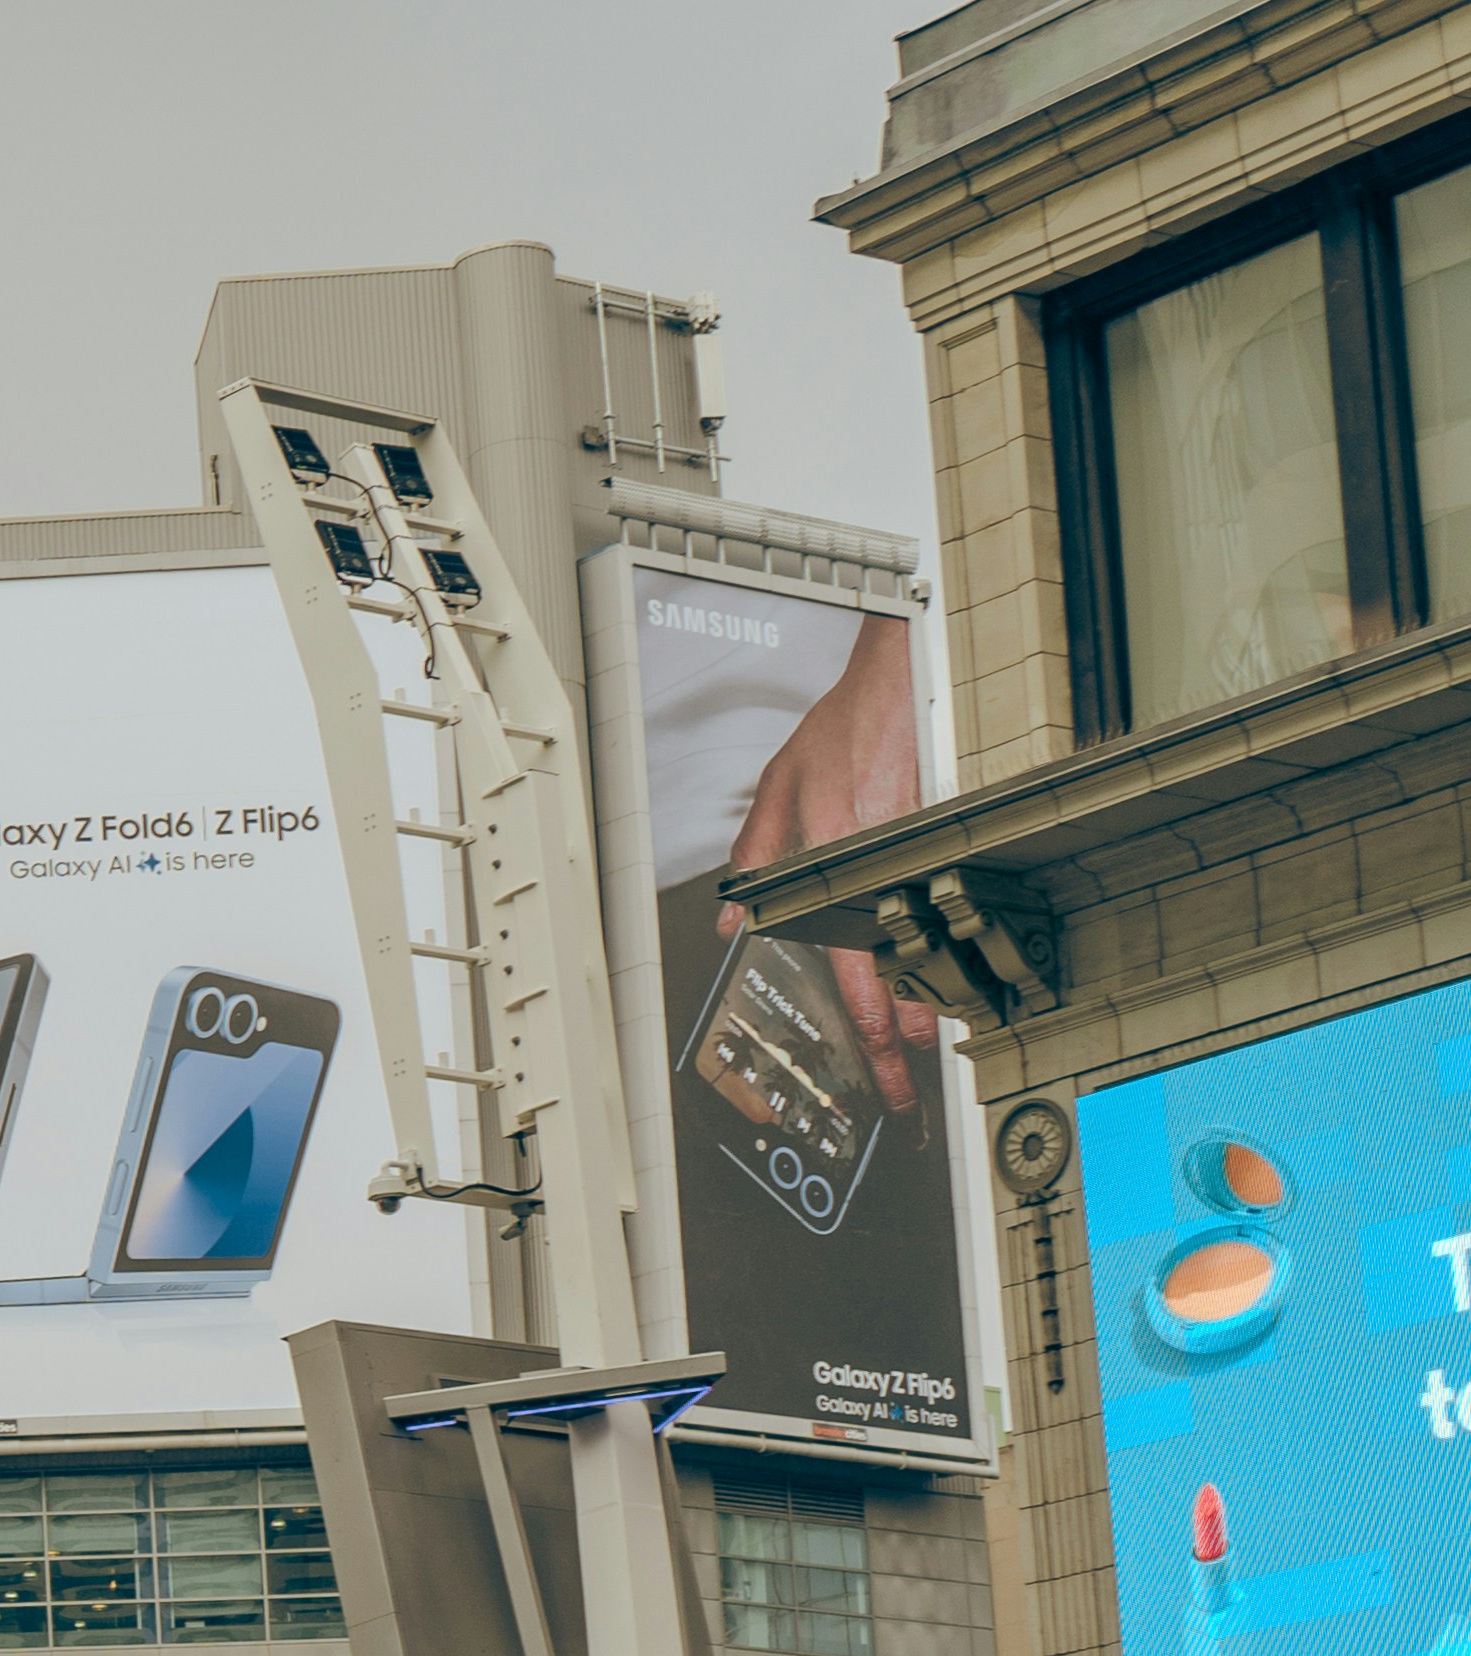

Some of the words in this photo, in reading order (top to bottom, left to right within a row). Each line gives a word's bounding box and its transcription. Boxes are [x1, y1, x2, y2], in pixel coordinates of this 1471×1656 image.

[647, 598, 780, 649] SAMSUNG
[74, 817, 92, 842] Z
[102, 811, 194, 841] Fold6
[215, 810, 233, 835] Z
[243, 806, 320, 841] Flip6
[9, 856, 102, 881] Galaxy
[108, 855, 131, 875] AI
[165, 851, 185, 871] is
[193, 850, 255, 871] here
[813, 1360, 889, 1396] Galaxy
[891, 1372, 906, 1394] Z
[906, 1372, 956, 1404] Flip6
[816, 1394, 872, 1421] Galaxy
[904, 1404, 921, 1424] is
[921, 1407, 958, 1428] here
